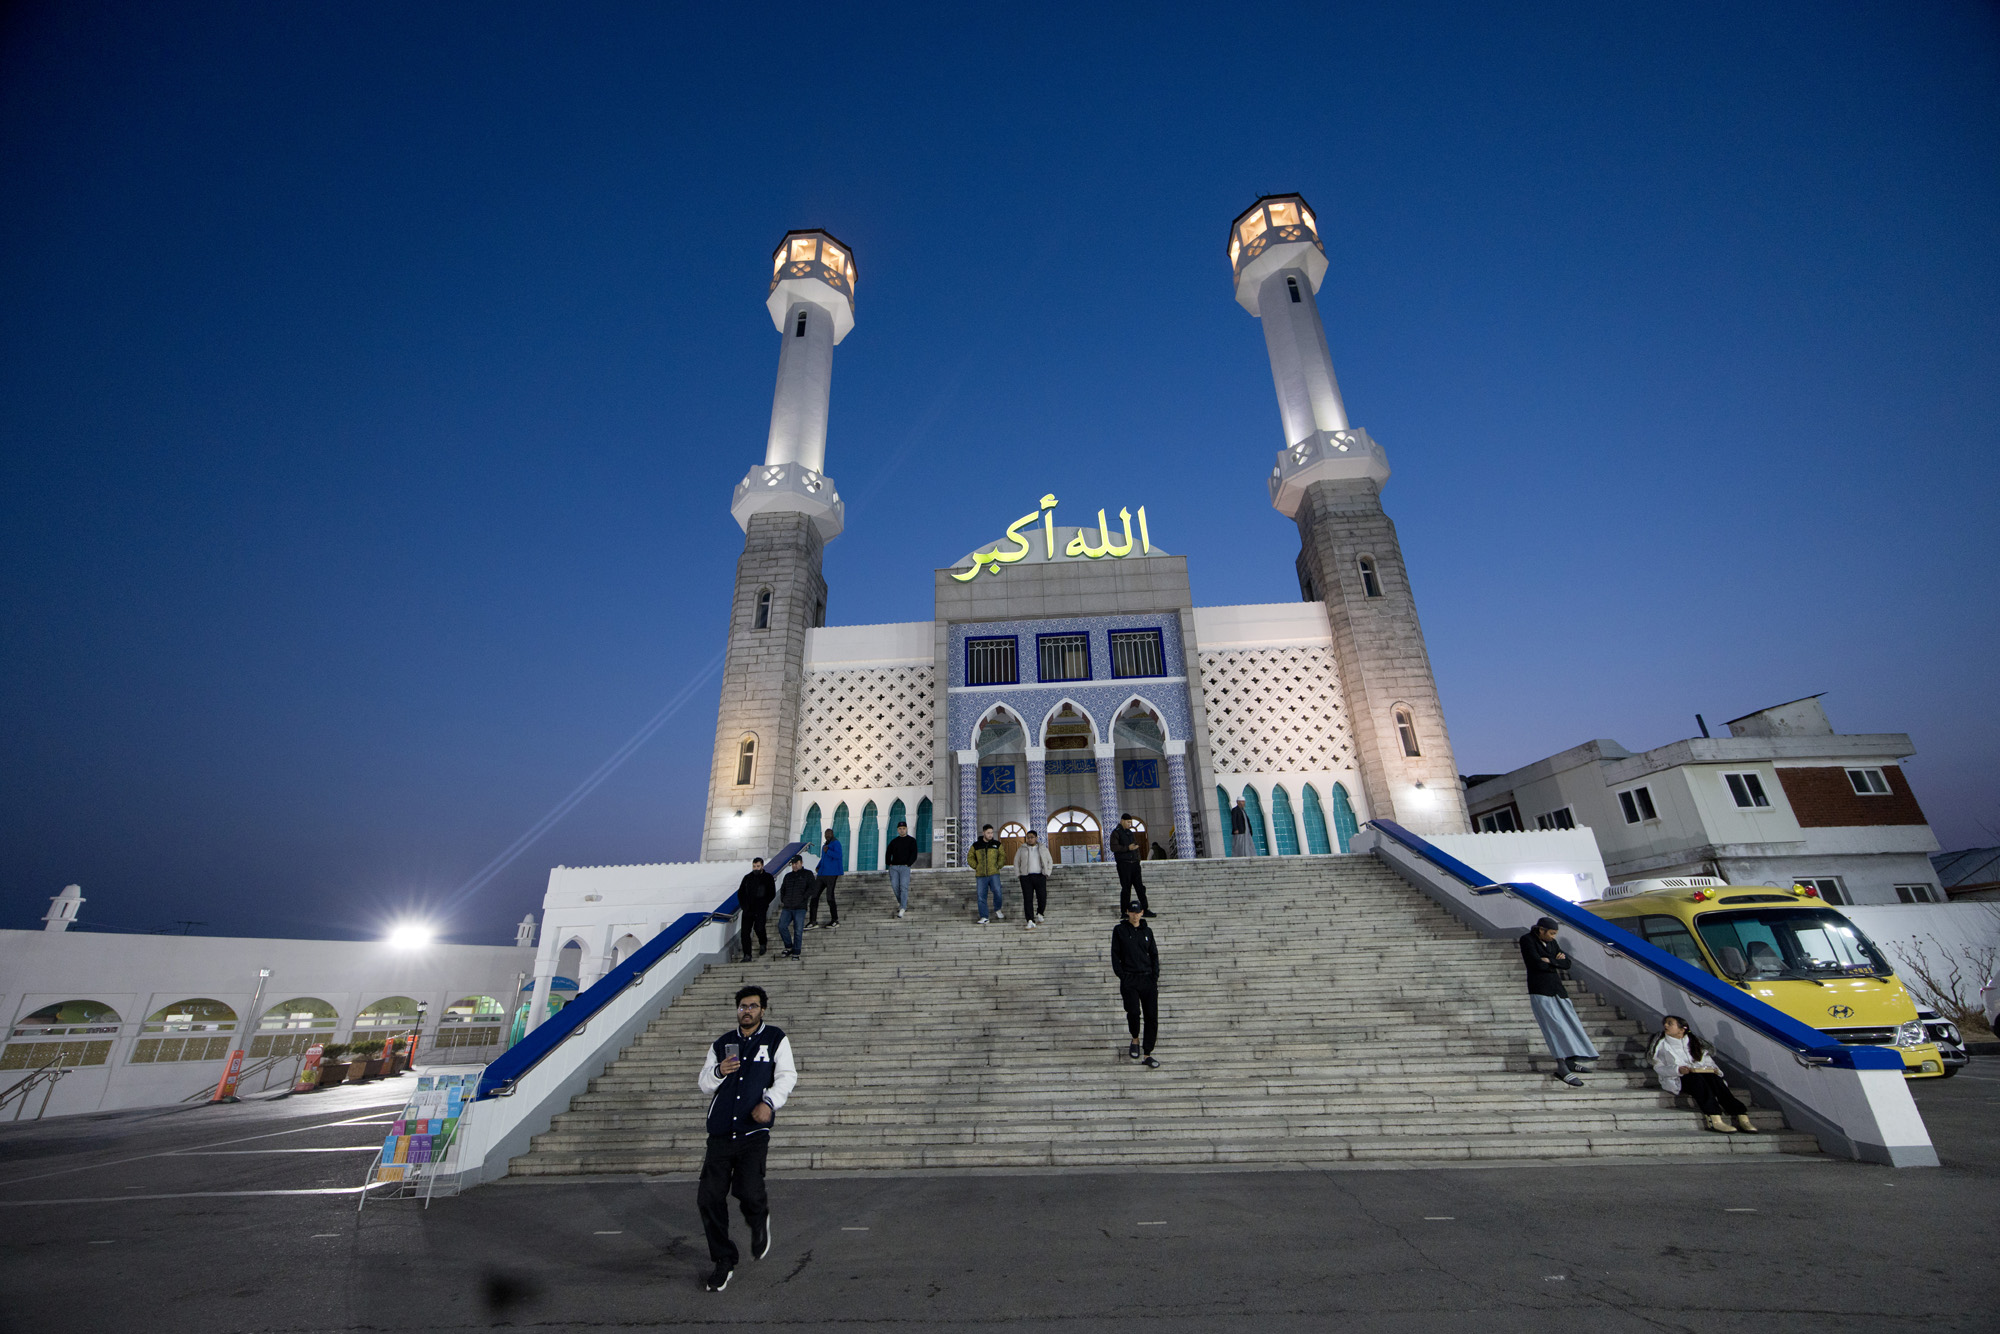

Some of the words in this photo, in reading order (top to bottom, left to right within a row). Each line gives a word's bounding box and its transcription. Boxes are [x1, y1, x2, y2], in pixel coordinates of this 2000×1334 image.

[950, 493, 1059, 583] أكبر
[1065, 505, 1150, 559] الله
[754, 1045, 770, 1062] A
